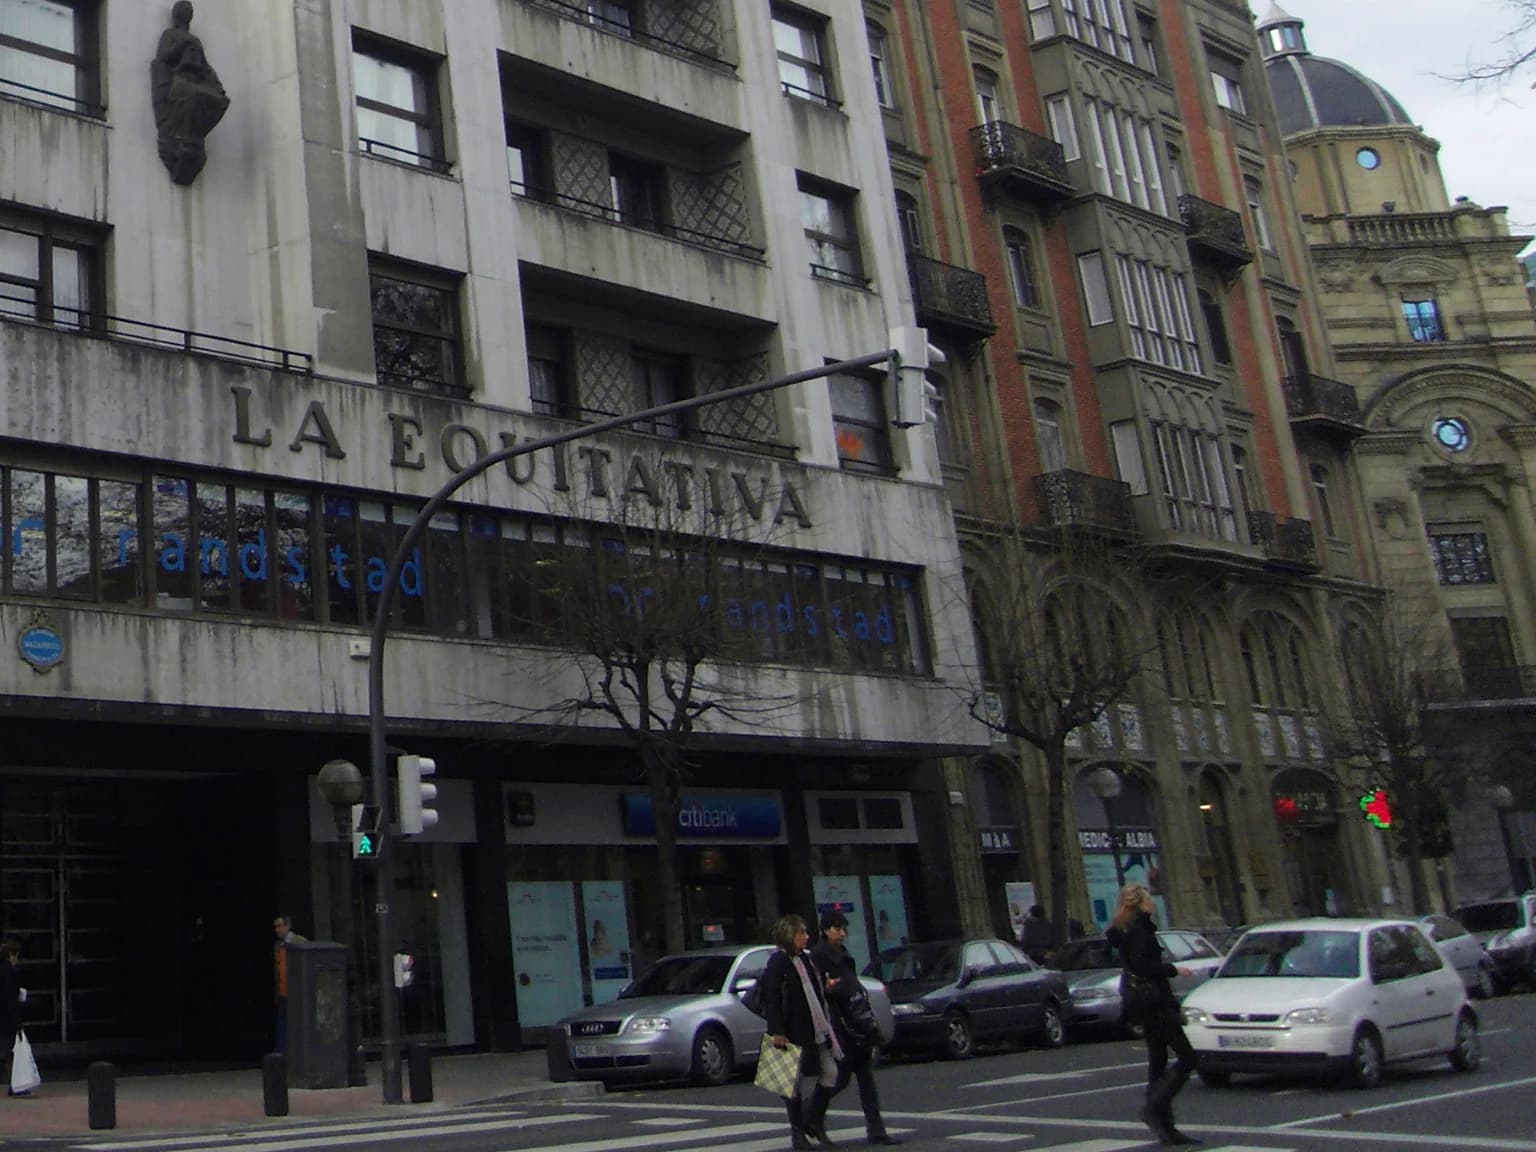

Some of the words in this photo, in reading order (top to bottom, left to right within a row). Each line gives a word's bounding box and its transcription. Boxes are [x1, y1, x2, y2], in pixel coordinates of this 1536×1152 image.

[230, 386, 346, 459] LA
[389, 412, 812, 529] EQUITATIVA
[118, 527, 423, 598] randstad
[679, 804, 737, 827] citibank
[1126, 831, 1157, 848] ALBIA
